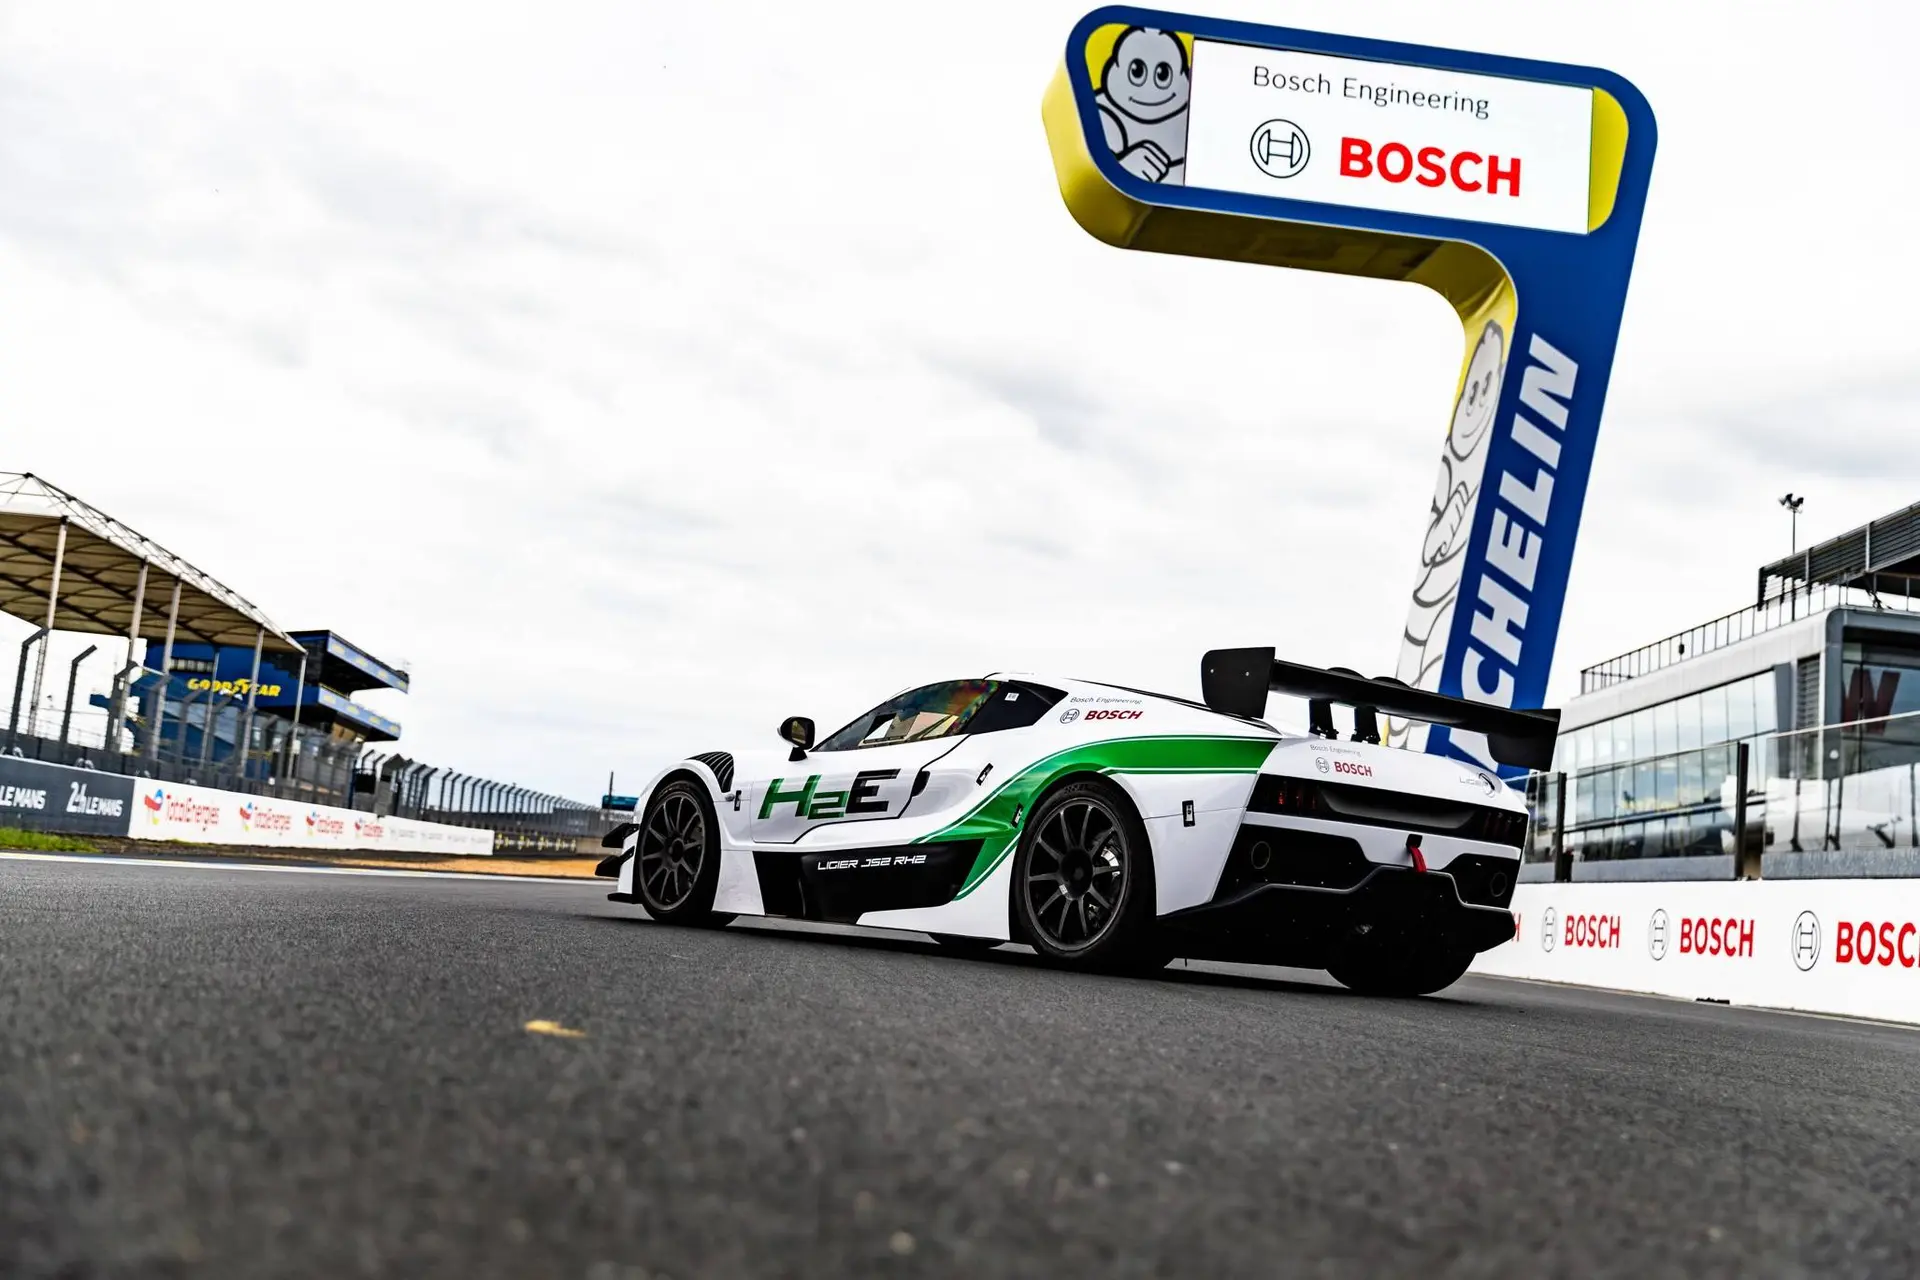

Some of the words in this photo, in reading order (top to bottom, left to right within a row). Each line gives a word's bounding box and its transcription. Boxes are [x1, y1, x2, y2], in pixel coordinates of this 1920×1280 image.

[1253, 65, 1331, 97] Bosch
[1343, 78, 1490, 120] Engineering
[1339, 136, 1521, 198] BOSCH
[1448, 333, 1579, 775] ICHELIN
[1084, 710, 1143, 721] BOSCH
[1334, 761, 1373, 777] BOSCH
[758, 768, 901, 820] H2E
[817, 859, 859, 870] LIGIER
[861, 857, 891, 868] JS2
[893, 855, 927, 866] RH2
[1564, 913, 1622, 949] BOSCH
[1679, 916, 1755, 958] BOSCH
[1835, 920, 1920, 970] BOSC
